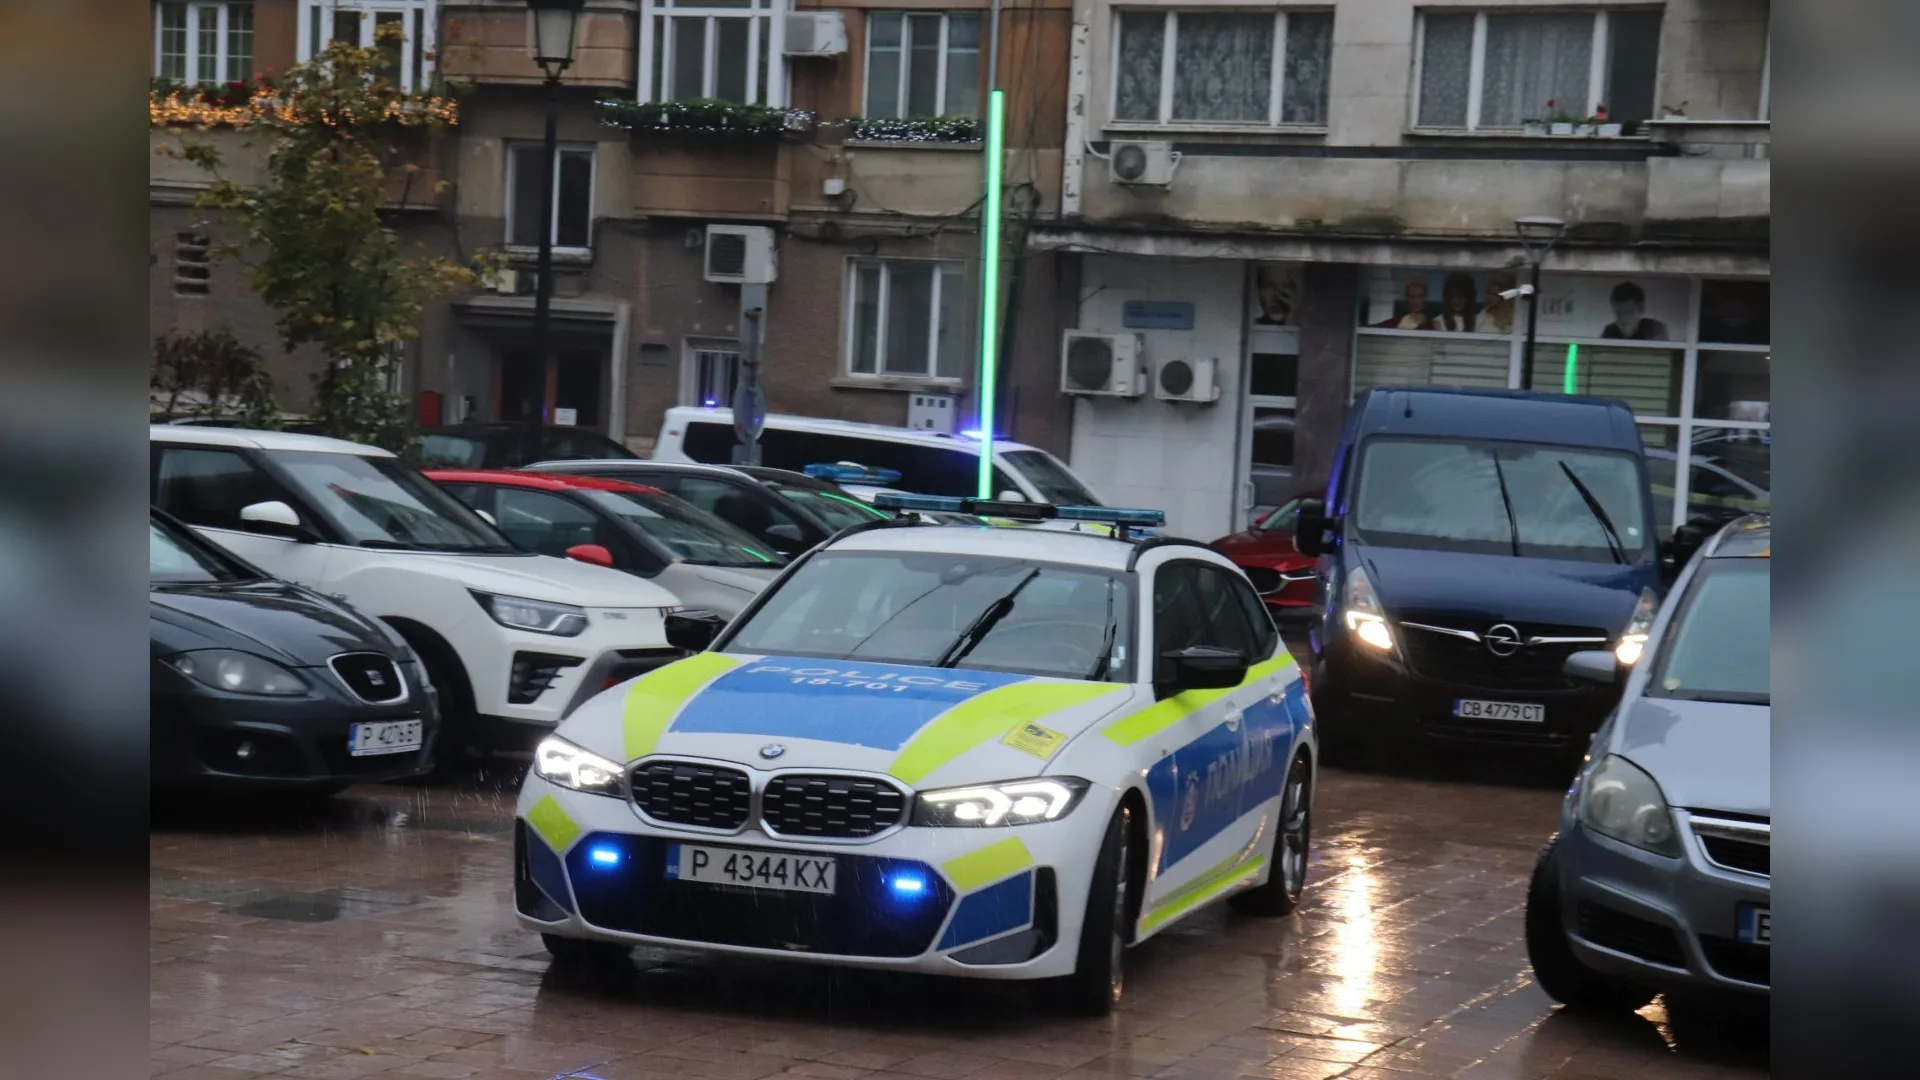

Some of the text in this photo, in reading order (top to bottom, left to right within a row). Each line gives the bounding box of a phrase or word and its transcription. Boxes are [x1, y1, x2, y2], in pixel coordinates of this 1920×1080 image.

[746, 665, 987, 692] POLICE
[791, 676, 909, 693] 18-701
[691, 850, 708, 876] P
